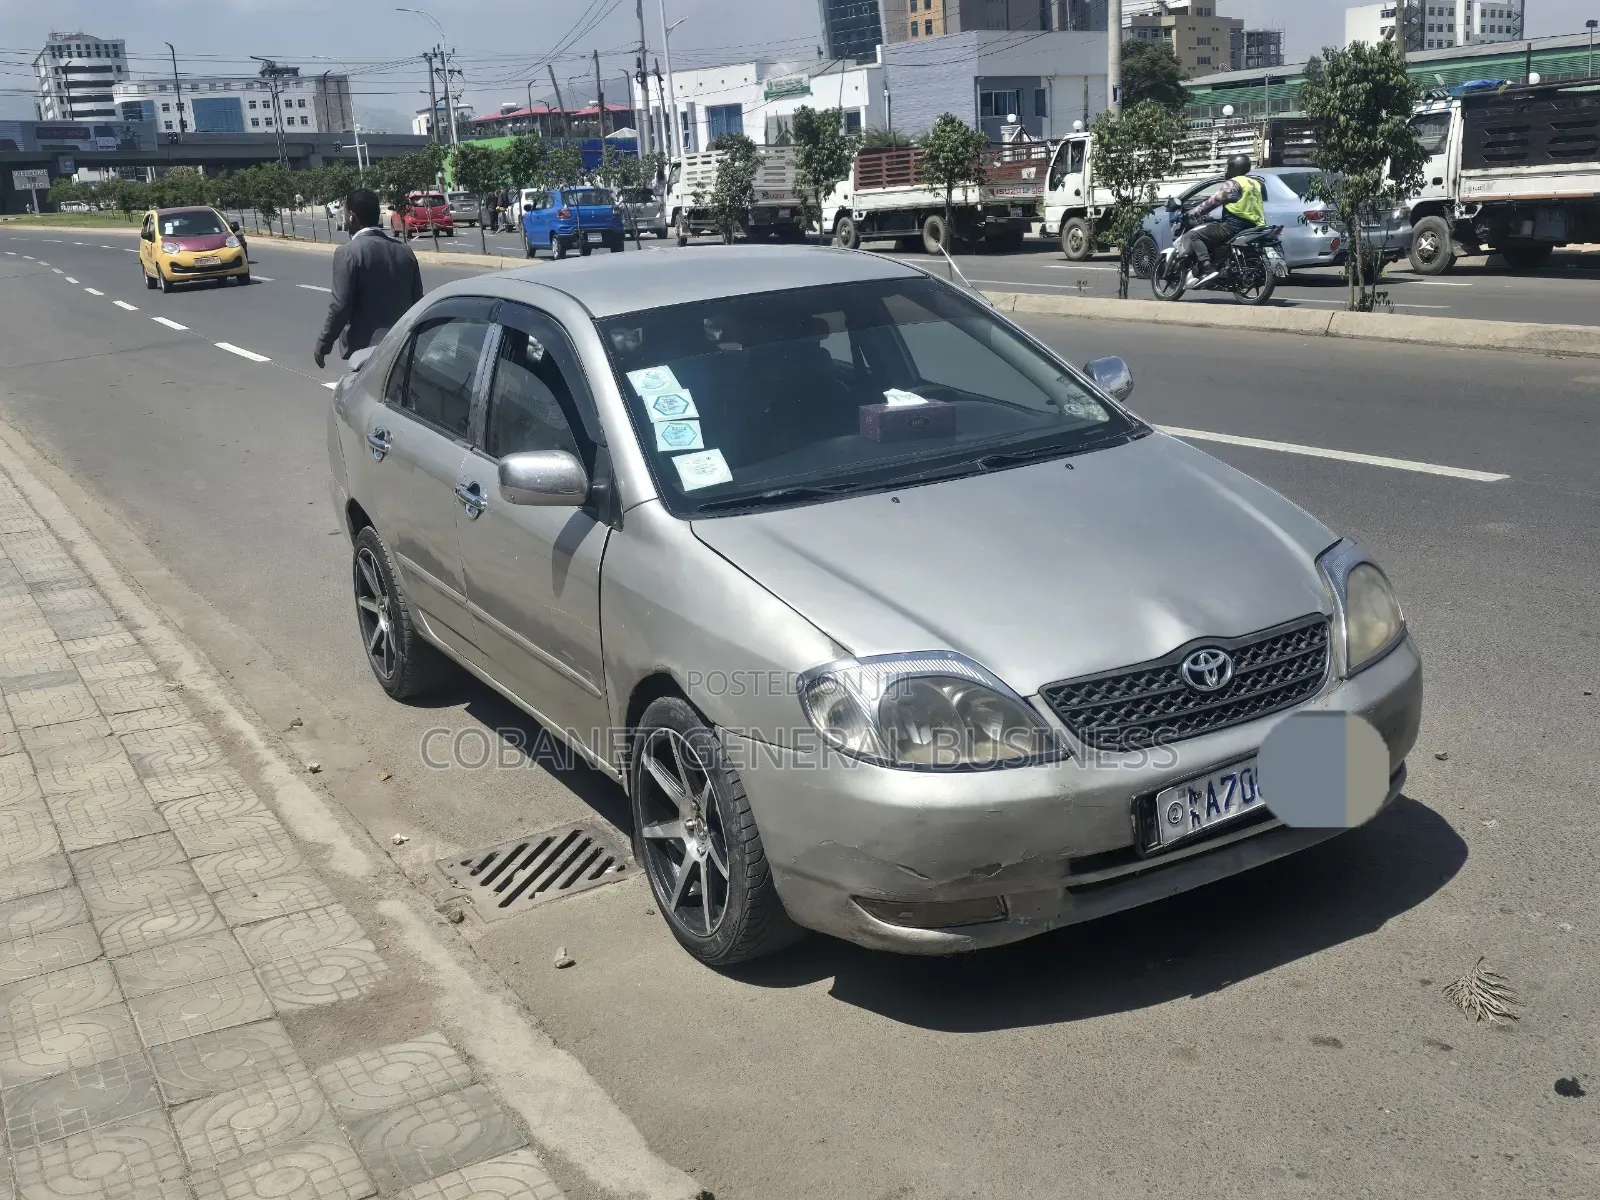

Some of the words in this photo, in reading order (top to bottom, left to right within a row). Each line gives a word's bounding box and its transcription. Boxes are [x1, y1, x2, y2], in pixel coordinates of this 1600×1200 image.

[13, 169, 48, 177] WELCOME
[996, 187, 1022, 195] ISUZU
[1205, 768, 1264, 817] A70
